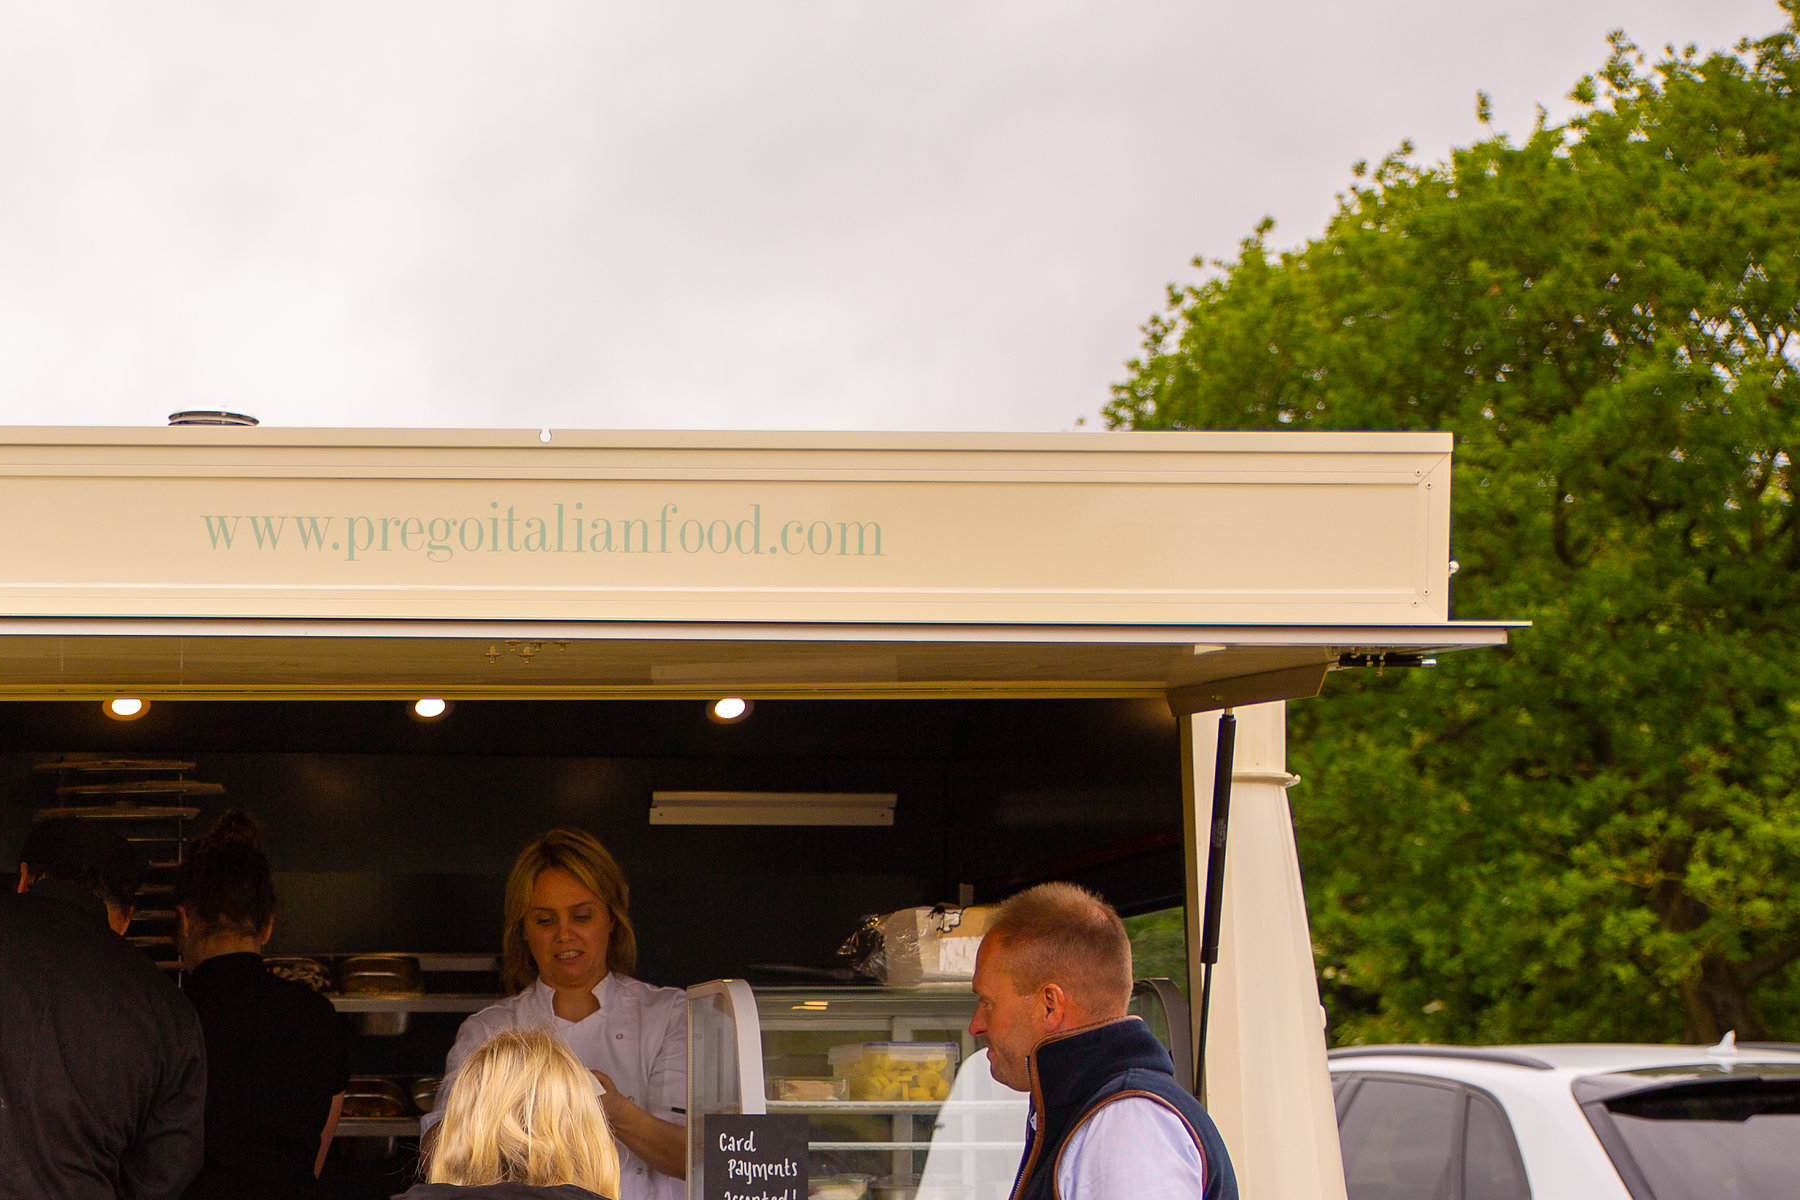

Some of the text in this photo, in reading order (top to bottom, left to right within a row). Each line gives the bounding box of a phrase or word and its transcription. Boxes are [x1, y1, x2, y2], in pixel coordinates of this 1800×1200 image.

[201, 501, 886, 563] www.pregoitalianfood.com
[719, 1130, 756, 1152] Card
[728, 1158, 798, 1185] Payments
